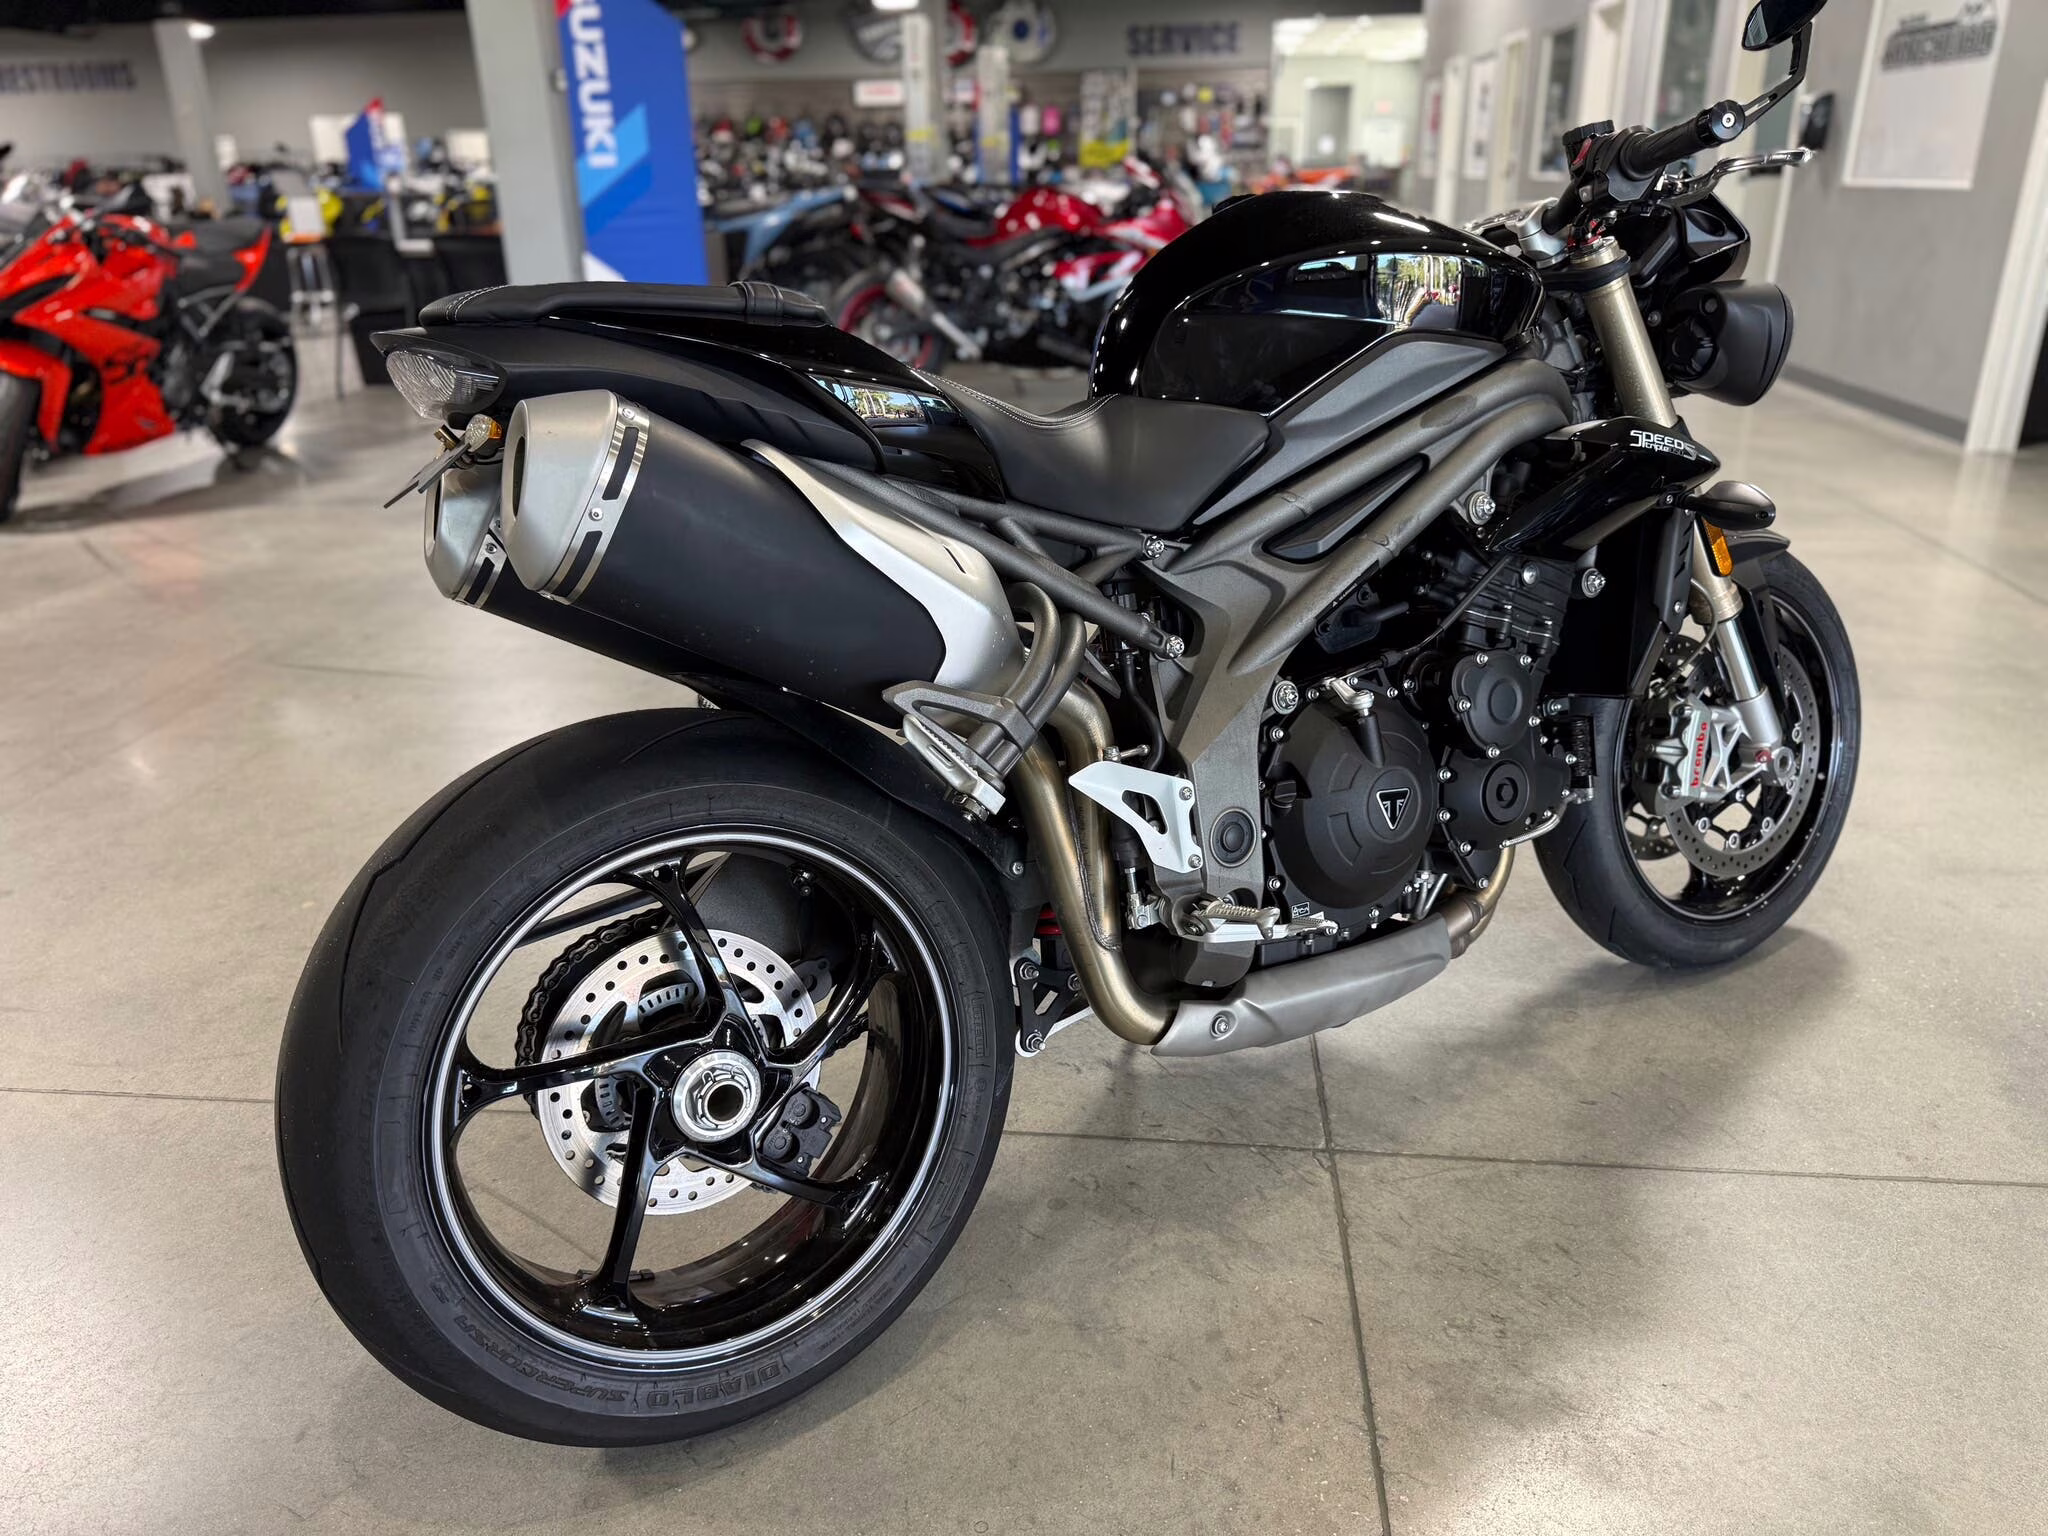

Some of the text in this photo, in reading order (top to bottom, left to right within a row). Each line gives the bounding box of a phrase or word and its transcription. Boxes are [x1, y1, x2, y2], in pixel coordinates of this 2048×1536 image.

[1126, 22, 1239, 58] SERVICE
[567, 0, 620, 169] UZUKI
[1629, 430, 1684, 449] SPEED
[1690, 722, 1708, 788] brembo
[454, 1315, 630, 1402] SUPERCORSA
[647, 1360, 781, 1408] DIABLO
